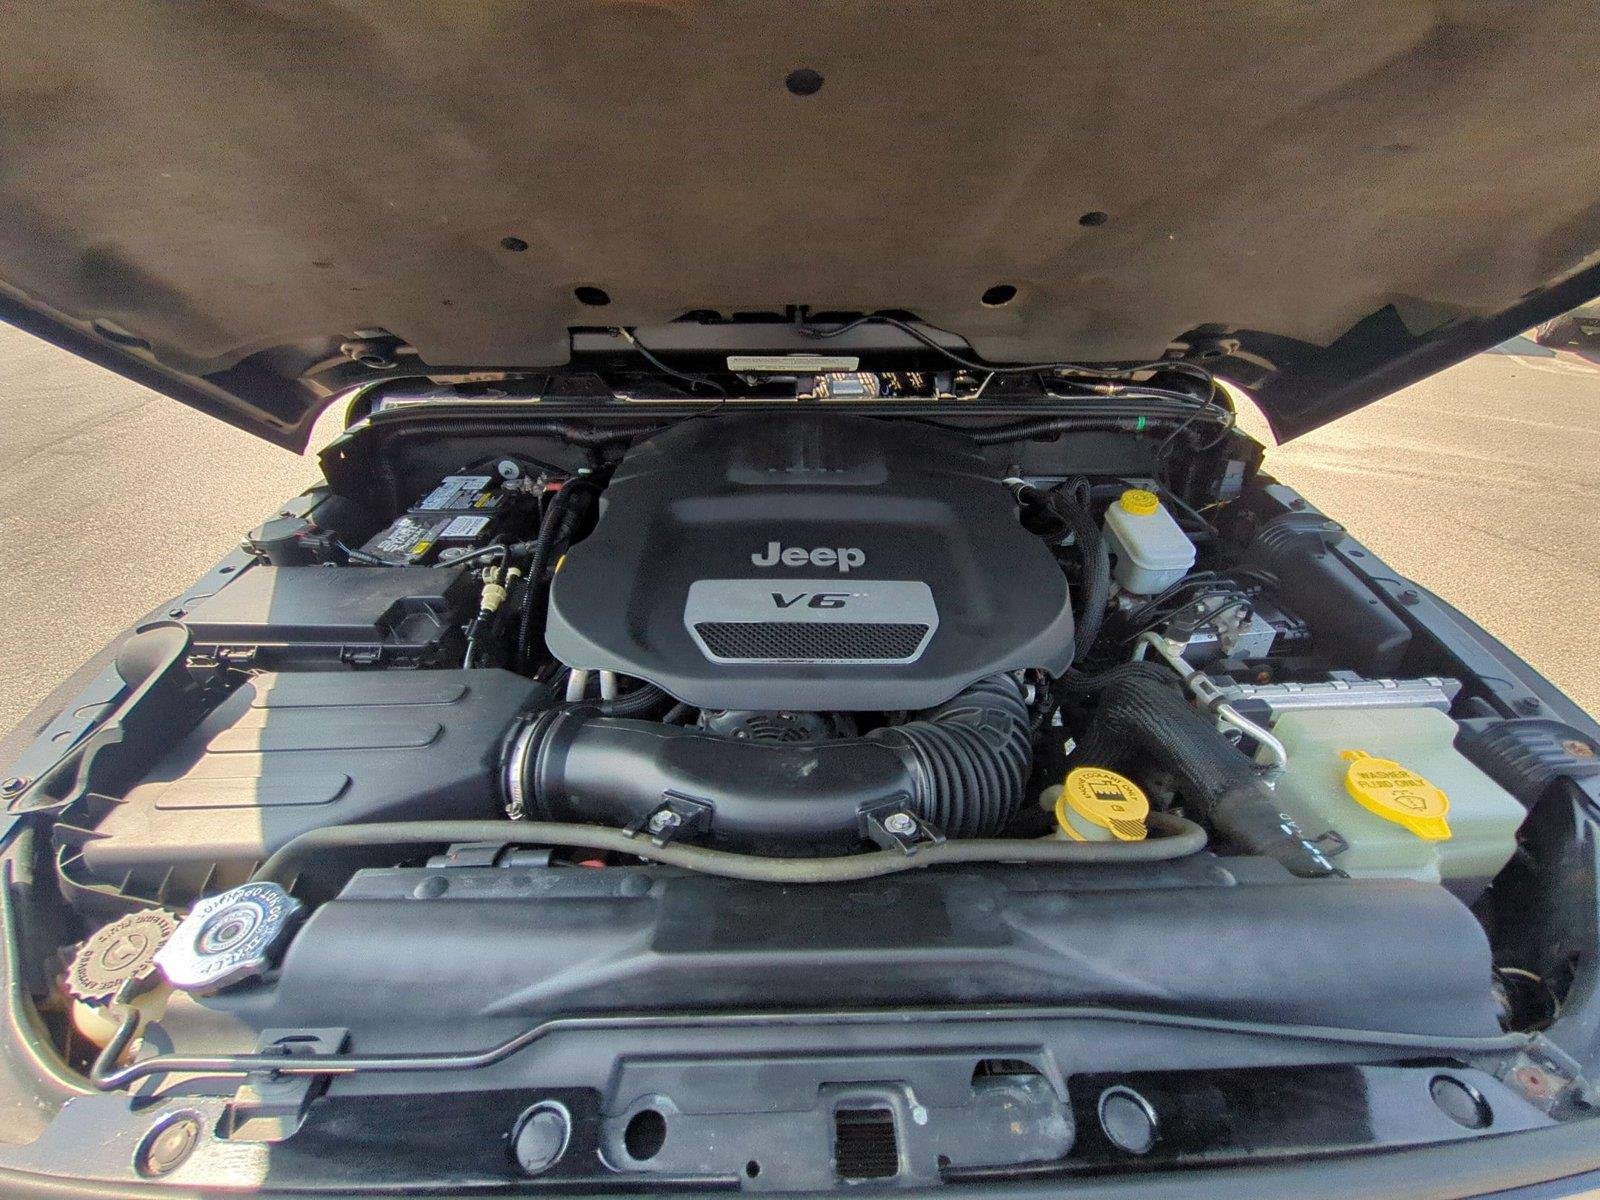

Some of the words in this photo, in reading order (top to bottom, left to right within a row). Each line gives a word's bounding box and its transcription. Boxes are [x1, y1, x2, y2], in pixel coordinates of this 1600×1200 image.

[751, 541, 866, 573] Jeep
[771, 592, 851, 609] V6
[1357, 770, 1409, 779] WASHER
[1357, 780, 1393, 788] FLUID
[1394, 779, 1425, 787] ONLY
[1122, 784, 1138, 801] ONLY
